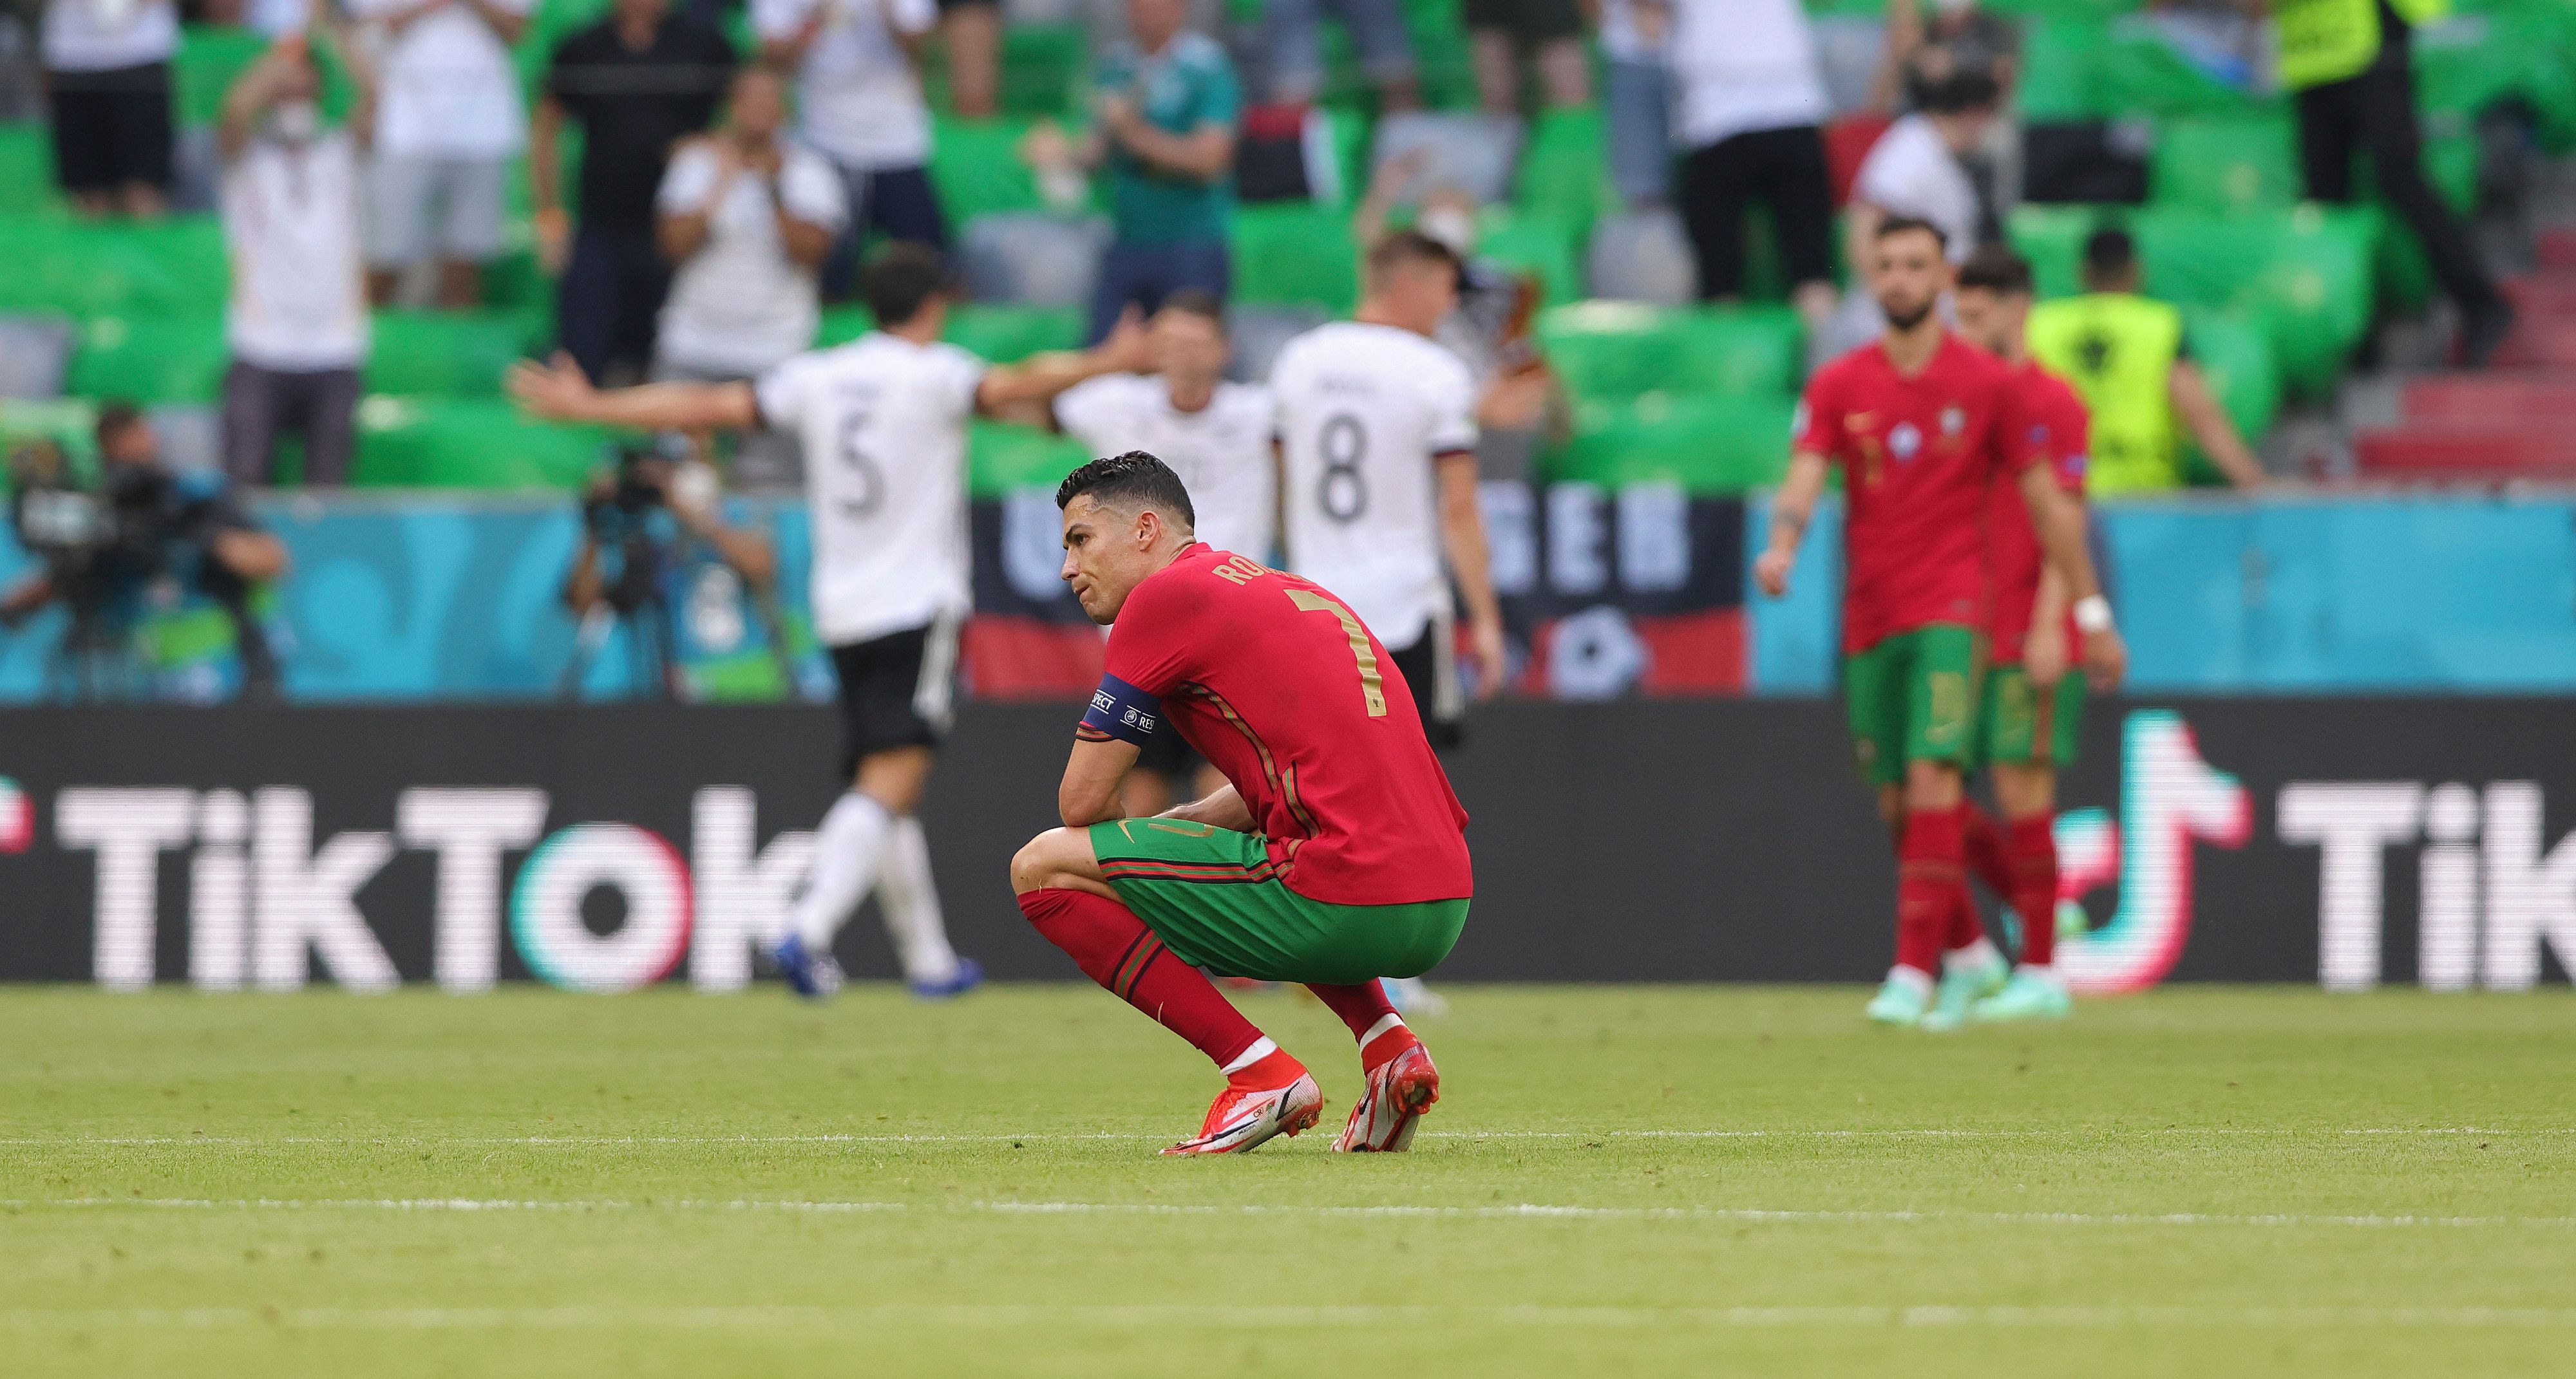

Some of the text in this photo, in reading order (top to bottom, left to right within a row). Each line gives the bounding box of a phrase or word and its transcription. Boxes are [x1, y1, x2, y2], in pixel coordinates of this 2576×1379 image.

[838, 409, 886, 518] 5
[1316, 410, 1370, 523] 8
[1283, 588, 1387, 717] 7
[55, 783, 824, 993] TikTok
